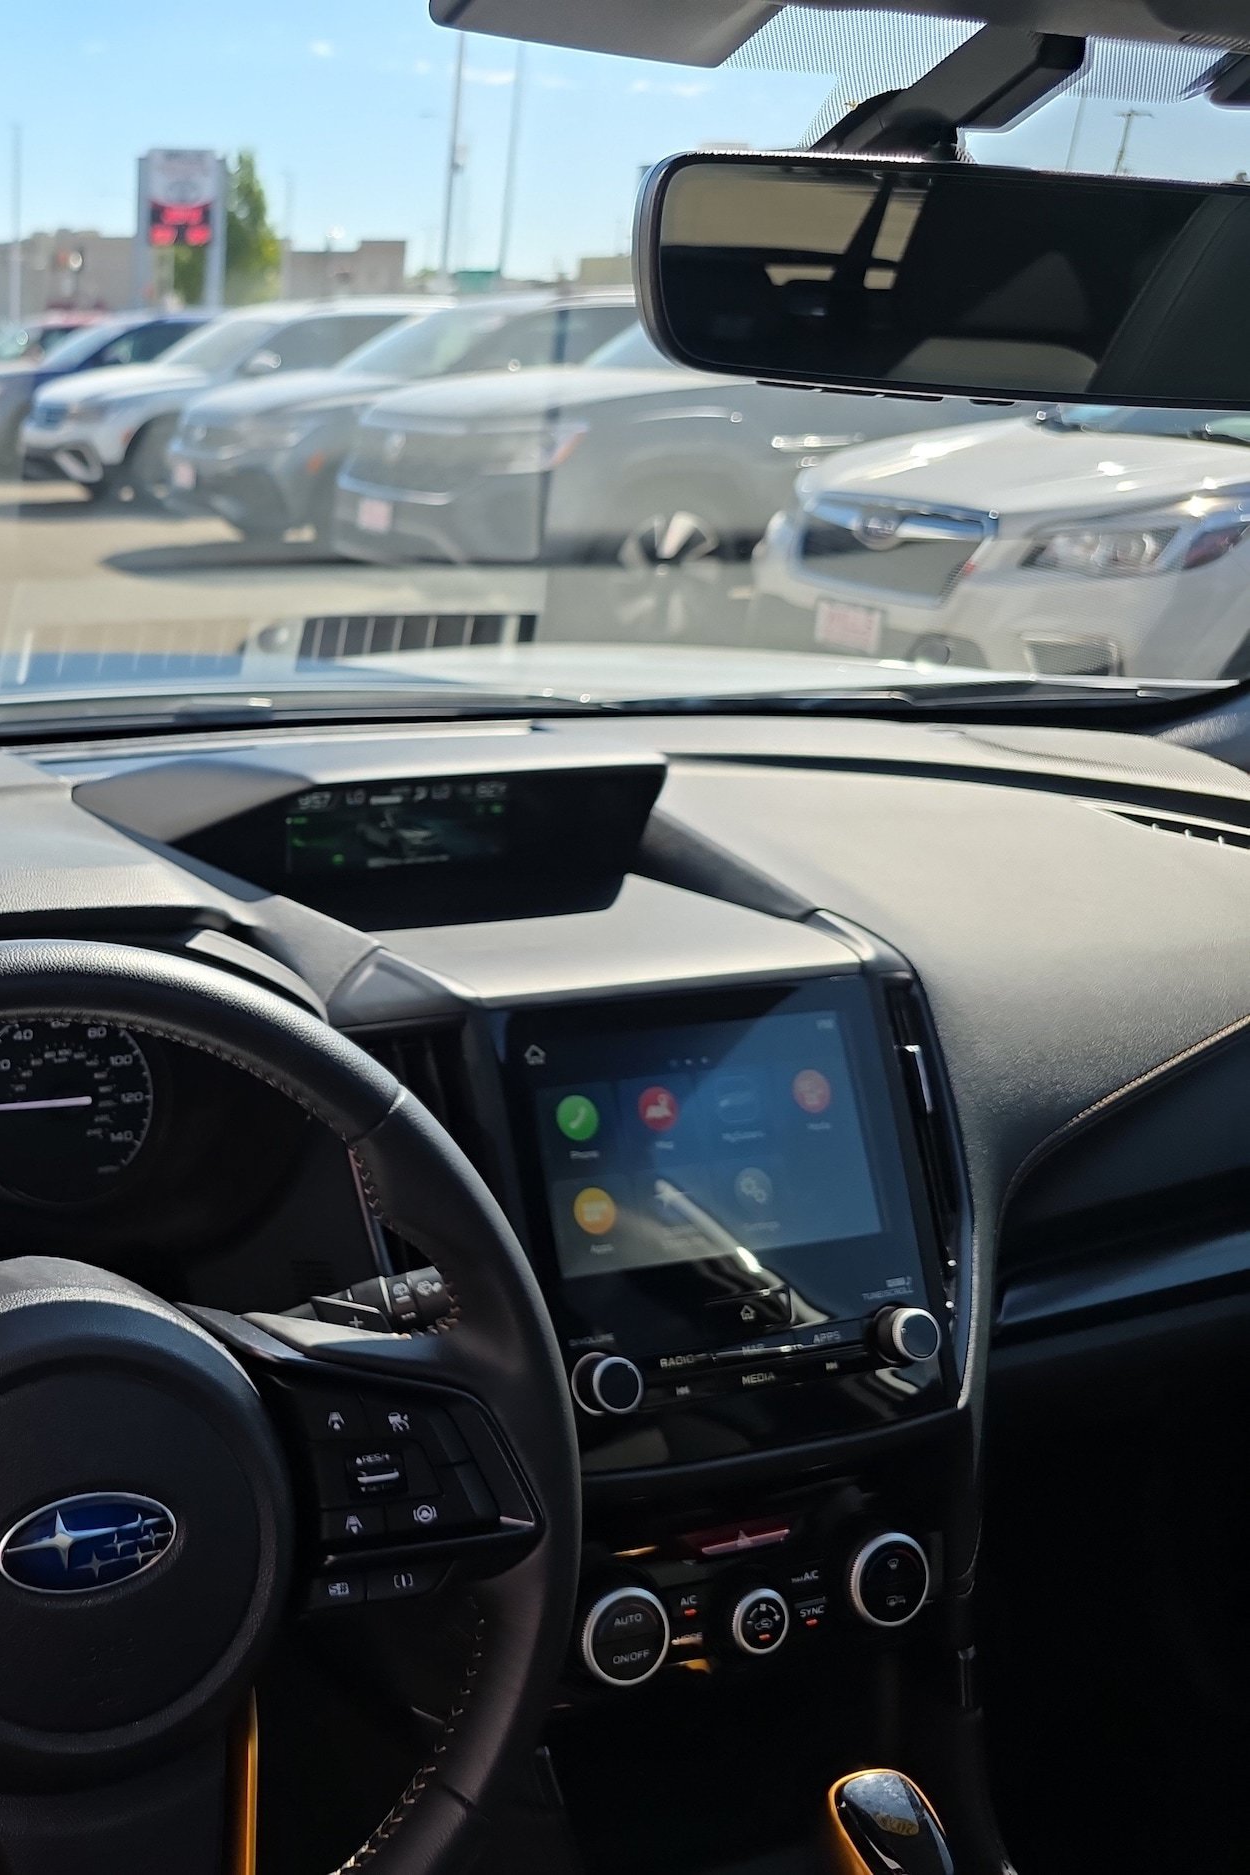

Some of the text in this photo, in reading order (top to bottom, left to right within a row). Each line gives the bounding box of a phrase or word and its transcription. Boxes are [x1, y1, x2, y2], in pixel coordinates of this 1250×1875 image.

[12, 1028, 34, 1042] 40
[109, 1053, 134, 1068] 100
[120, 1090, 144, 1104] 120
[109, 1129, 134, 1143] 140
[813, 1330, 842, 1344] APPS
[659, 1354, 695, 1369] RADIO
[741, 1371, 777, 1386] MEDIA
[680, 1594, 698, 1607] A/C
[799, 1604, 825, 1618] SYNC
[613, 1612, 643, 1627] AUTO
[612, 1649, 650, 1666] ON/OFF
